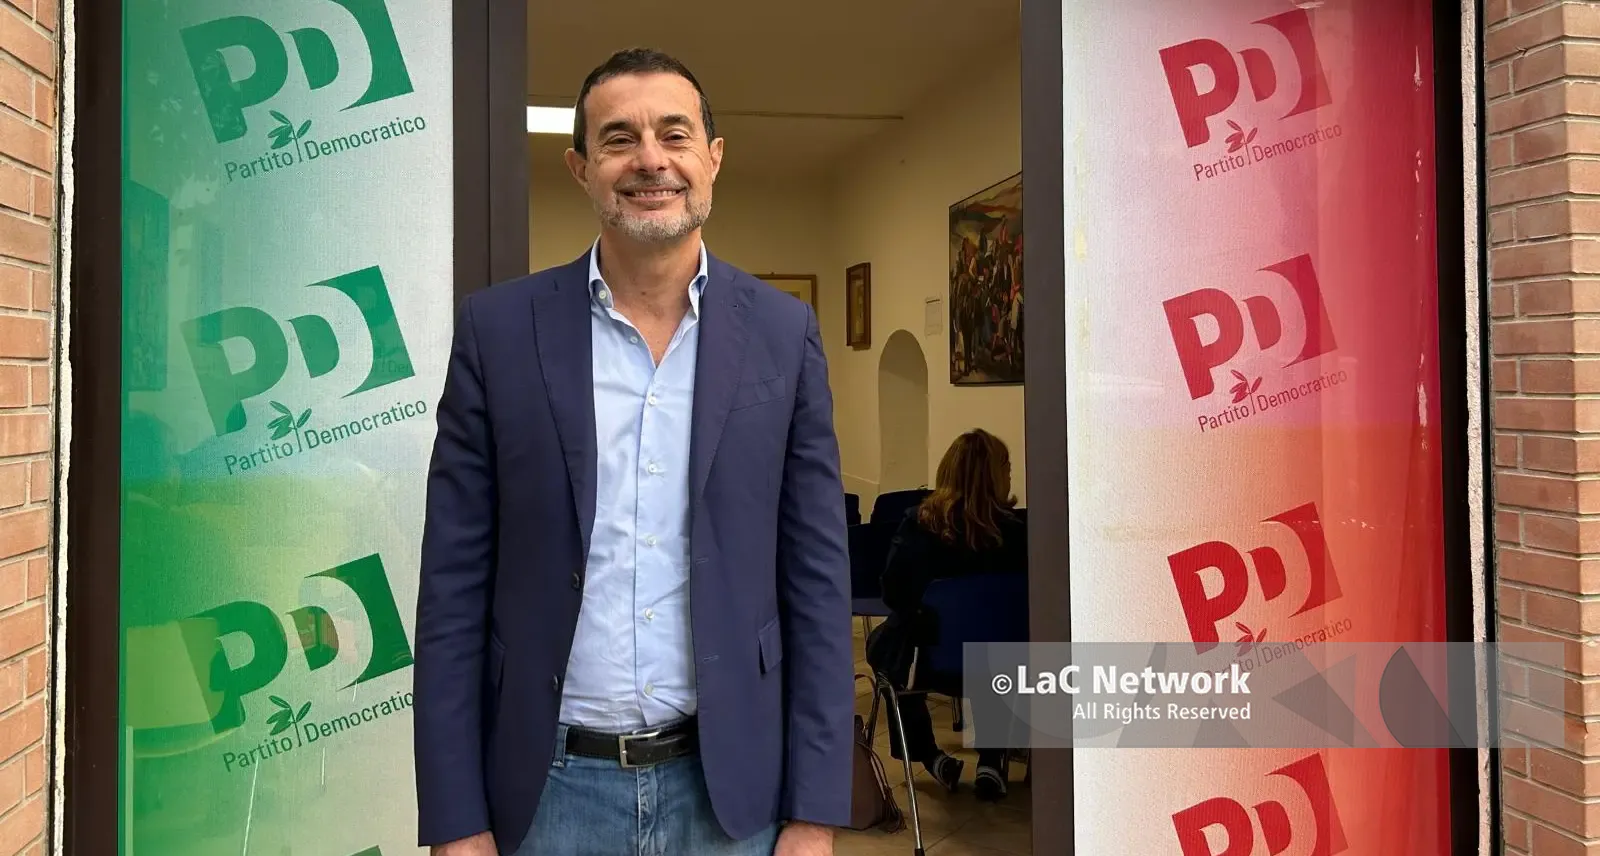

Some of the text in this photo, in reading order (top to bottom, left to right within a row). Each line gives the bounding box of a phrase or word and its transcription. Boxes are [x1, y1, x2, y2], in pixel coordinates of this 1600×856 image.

[179, 0, 414, 144] PD
[1158, 8, 1333, 148] PD
[224, 115, 426, 185] Partito Democratico
[1193, 124, 1342, 182] Partito Democratico
[179, 264, 416, 437] PD
[1162, 253, 1338, 401] PD
[224, 399, 427, 475] Partito Democratico
[1197, 369, 1348, 433] Partito Democratico
[1167, 501, 1343, 656] PD
[177, 552, 414, 735] PD
[1261, 616, 1353, 664] Democratico
[222, 690, 414, 773] Partito Democratic
